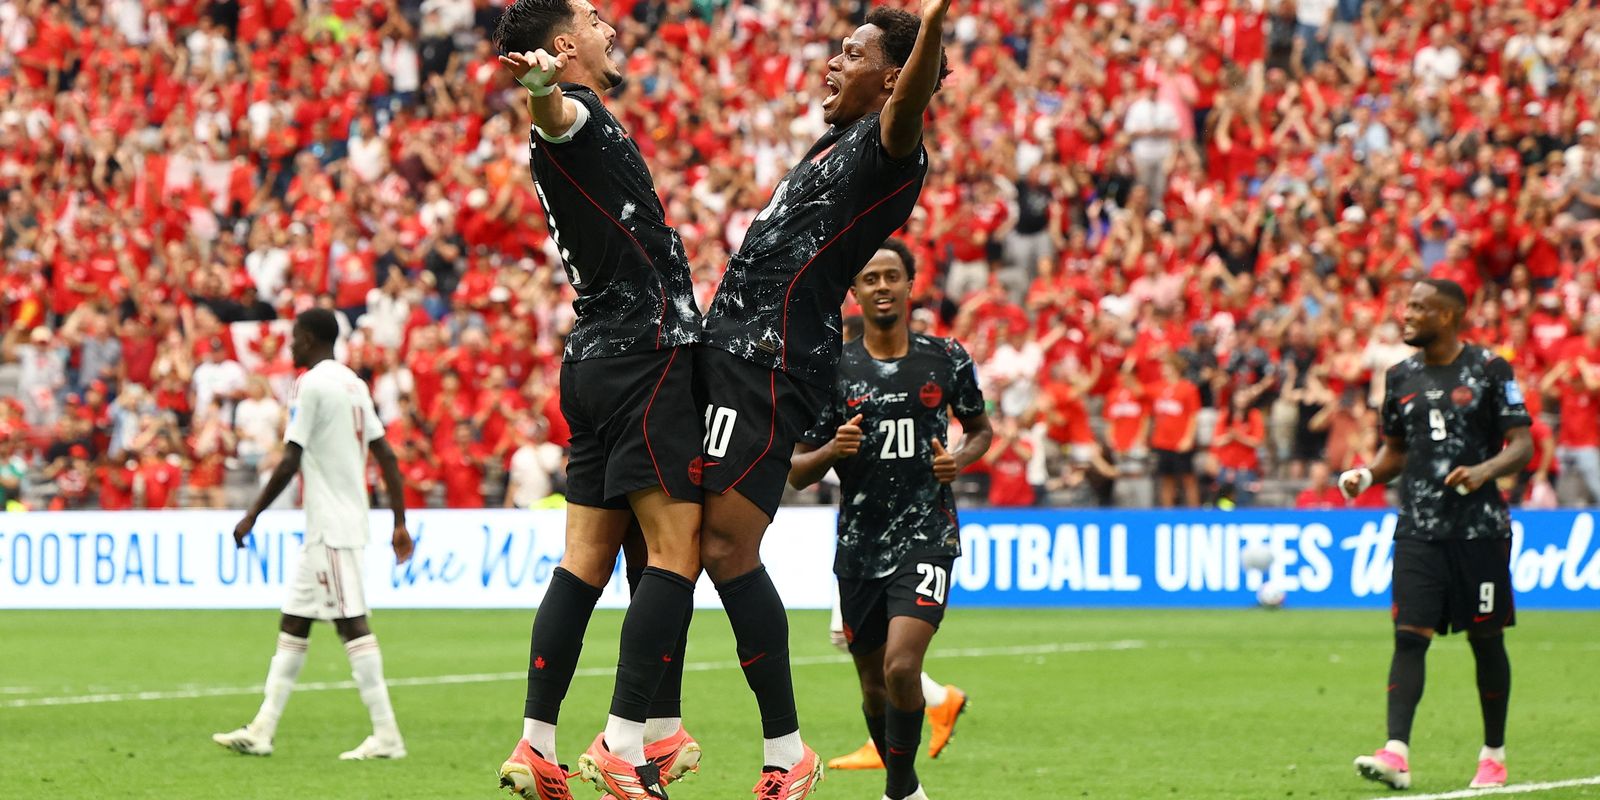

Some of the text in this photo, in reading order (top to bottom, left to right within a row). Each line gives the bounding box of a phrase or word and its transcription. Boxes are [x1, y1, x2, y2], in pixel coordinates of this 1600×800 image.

[703, 404, 737, 458] 10
[879, 418, 915, 459] 20
[1429, 408, 1447, 441] 9
[0, 532, 195, 585] OOTBALL
[481, 525, 563, 587] Wo
[951, 523, 1142, 591] OTBALL
[316, 571, 330, 594] 4
[915, 562, 947, 605] 20
[1478, 582, 1495, 613] 9
